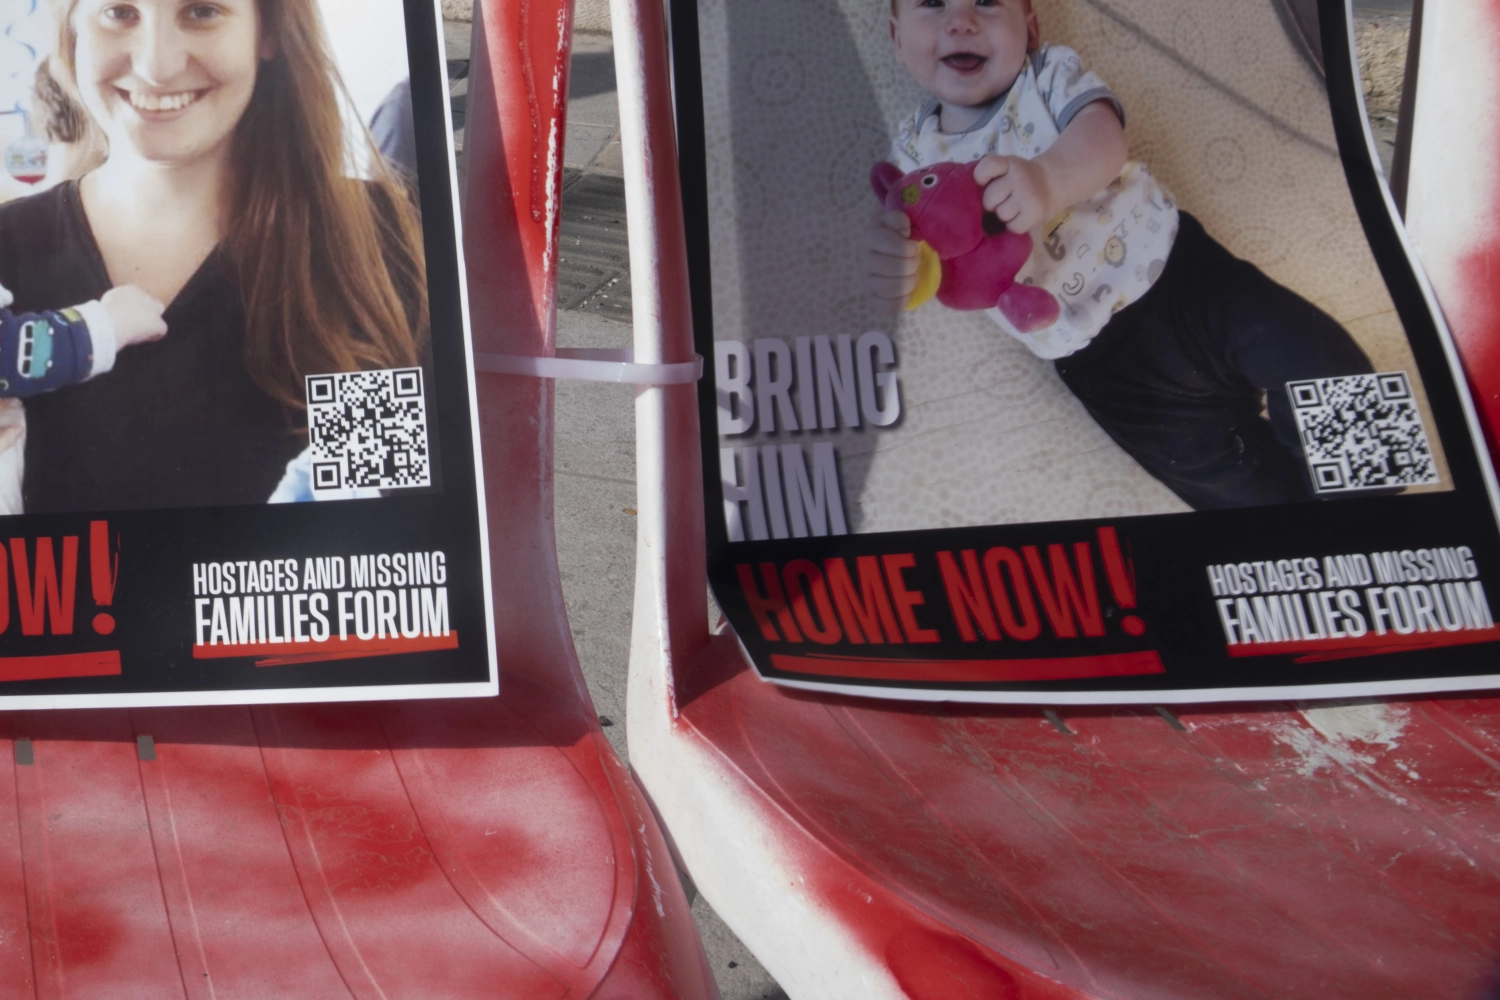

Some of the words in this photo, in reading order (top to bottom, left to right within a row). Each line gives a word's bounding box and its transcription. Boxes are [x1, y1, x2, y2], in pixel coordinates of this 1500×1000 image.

[714, 331, 900, 435] BRING
[719, 441, 848, 542] HIM
[193, 559, 298, 595] HOSTAGES
[303, 556, 345, 590] AND
[350, 551, 447, 588] MISSING
[736, 553, 940, 645] HOME
[936, 526, 1146, 641] NOW!
[1206, 557, 1323, 596] HOSTAGES
[1323, 554, 1373, 588] AND
[1369, 546, 1478, 584] MISSING
[195, 592, 330, 646] FAMILIES
[337, 587, 450, 641] FORUM
[1216, 589, 1368, 645] FAMILIES
[1365, 581, 1494, 636] FORUM
